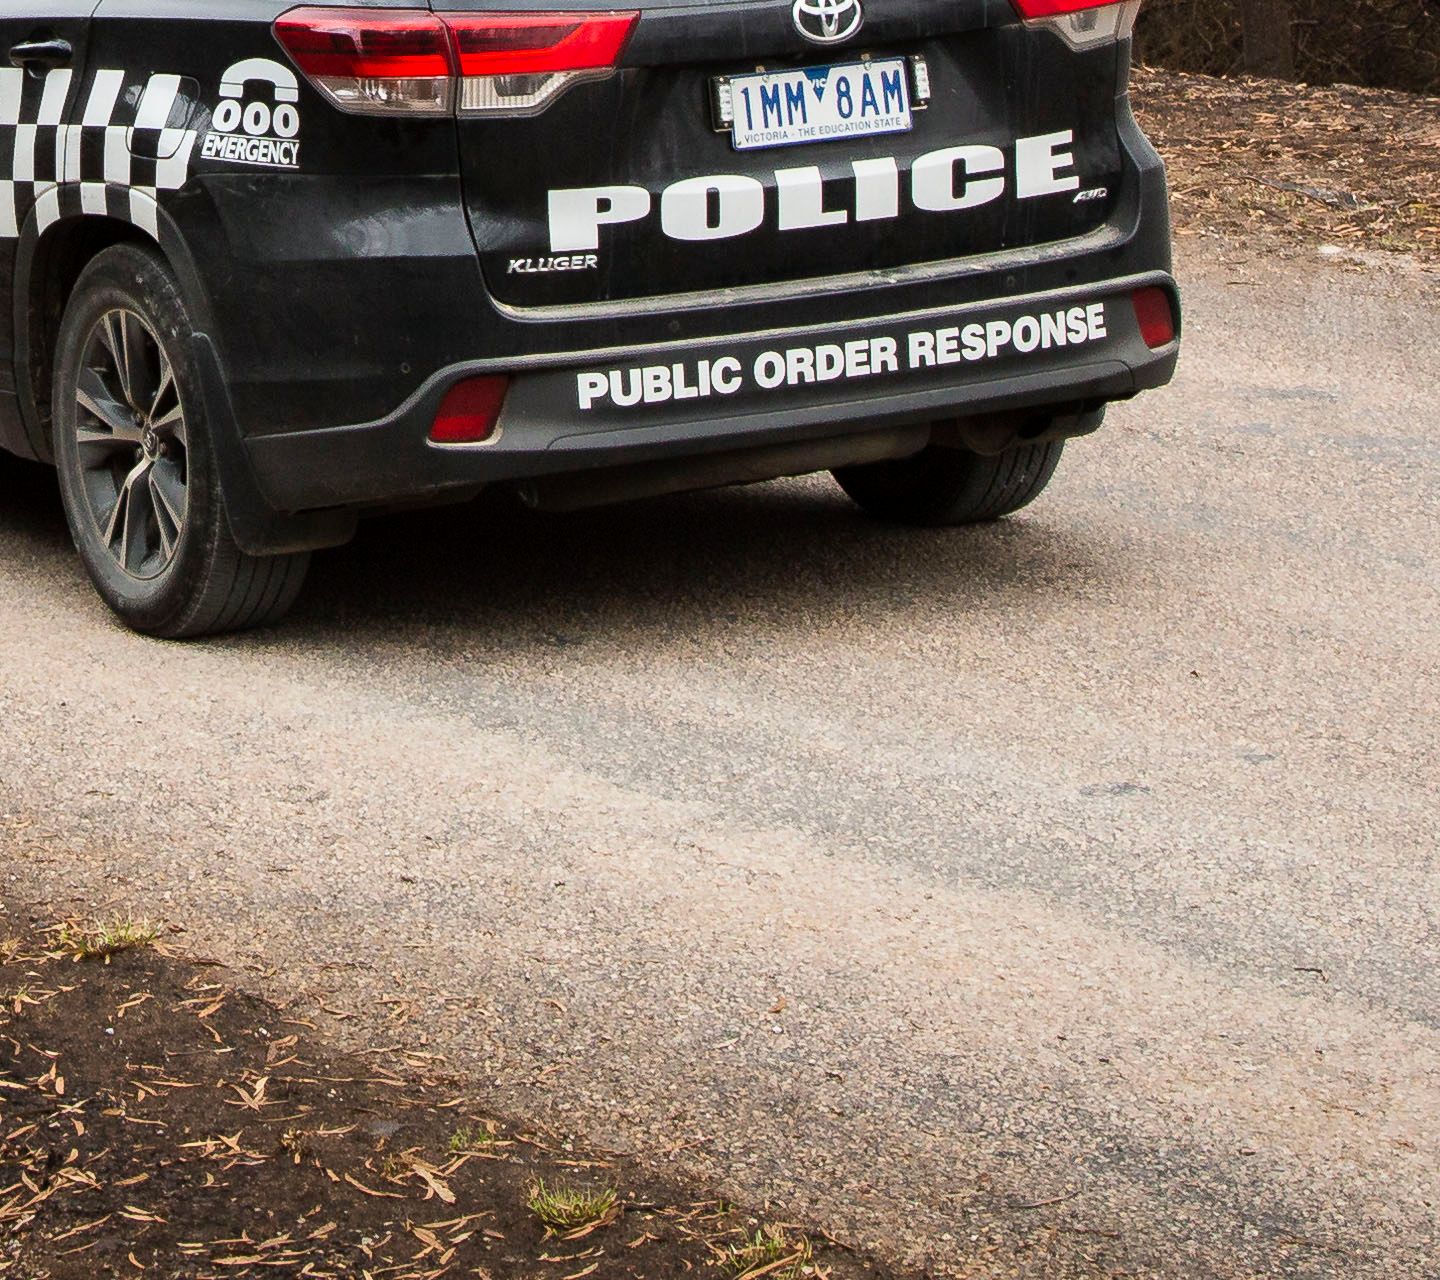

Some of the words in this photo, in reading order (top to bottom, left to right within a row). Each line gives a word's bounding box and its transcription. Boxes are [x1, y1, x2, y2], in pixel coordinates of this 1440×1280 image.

[211, 99, 300, 138] 000
[740, 80, 808, 131] 1MM
[835, 69, 904, 120] 8AM
[200, 134, 300, 165] EMERGENCY
[744, 130, 789, 144] VICTORIA
[798, 124, 817, 137] THE
[819, 120, 871, 135] EDUCATION
[873, 116, 902, 130] STATE
[547, 129, 1080, 252] POLICE
[506, 254, 598, 274] KLUGER
[577, 357, 743, 410] PUBLIC
[753, 337, 899, 390] ORDER
[908, 303, 1108, 368] RESPONSE
